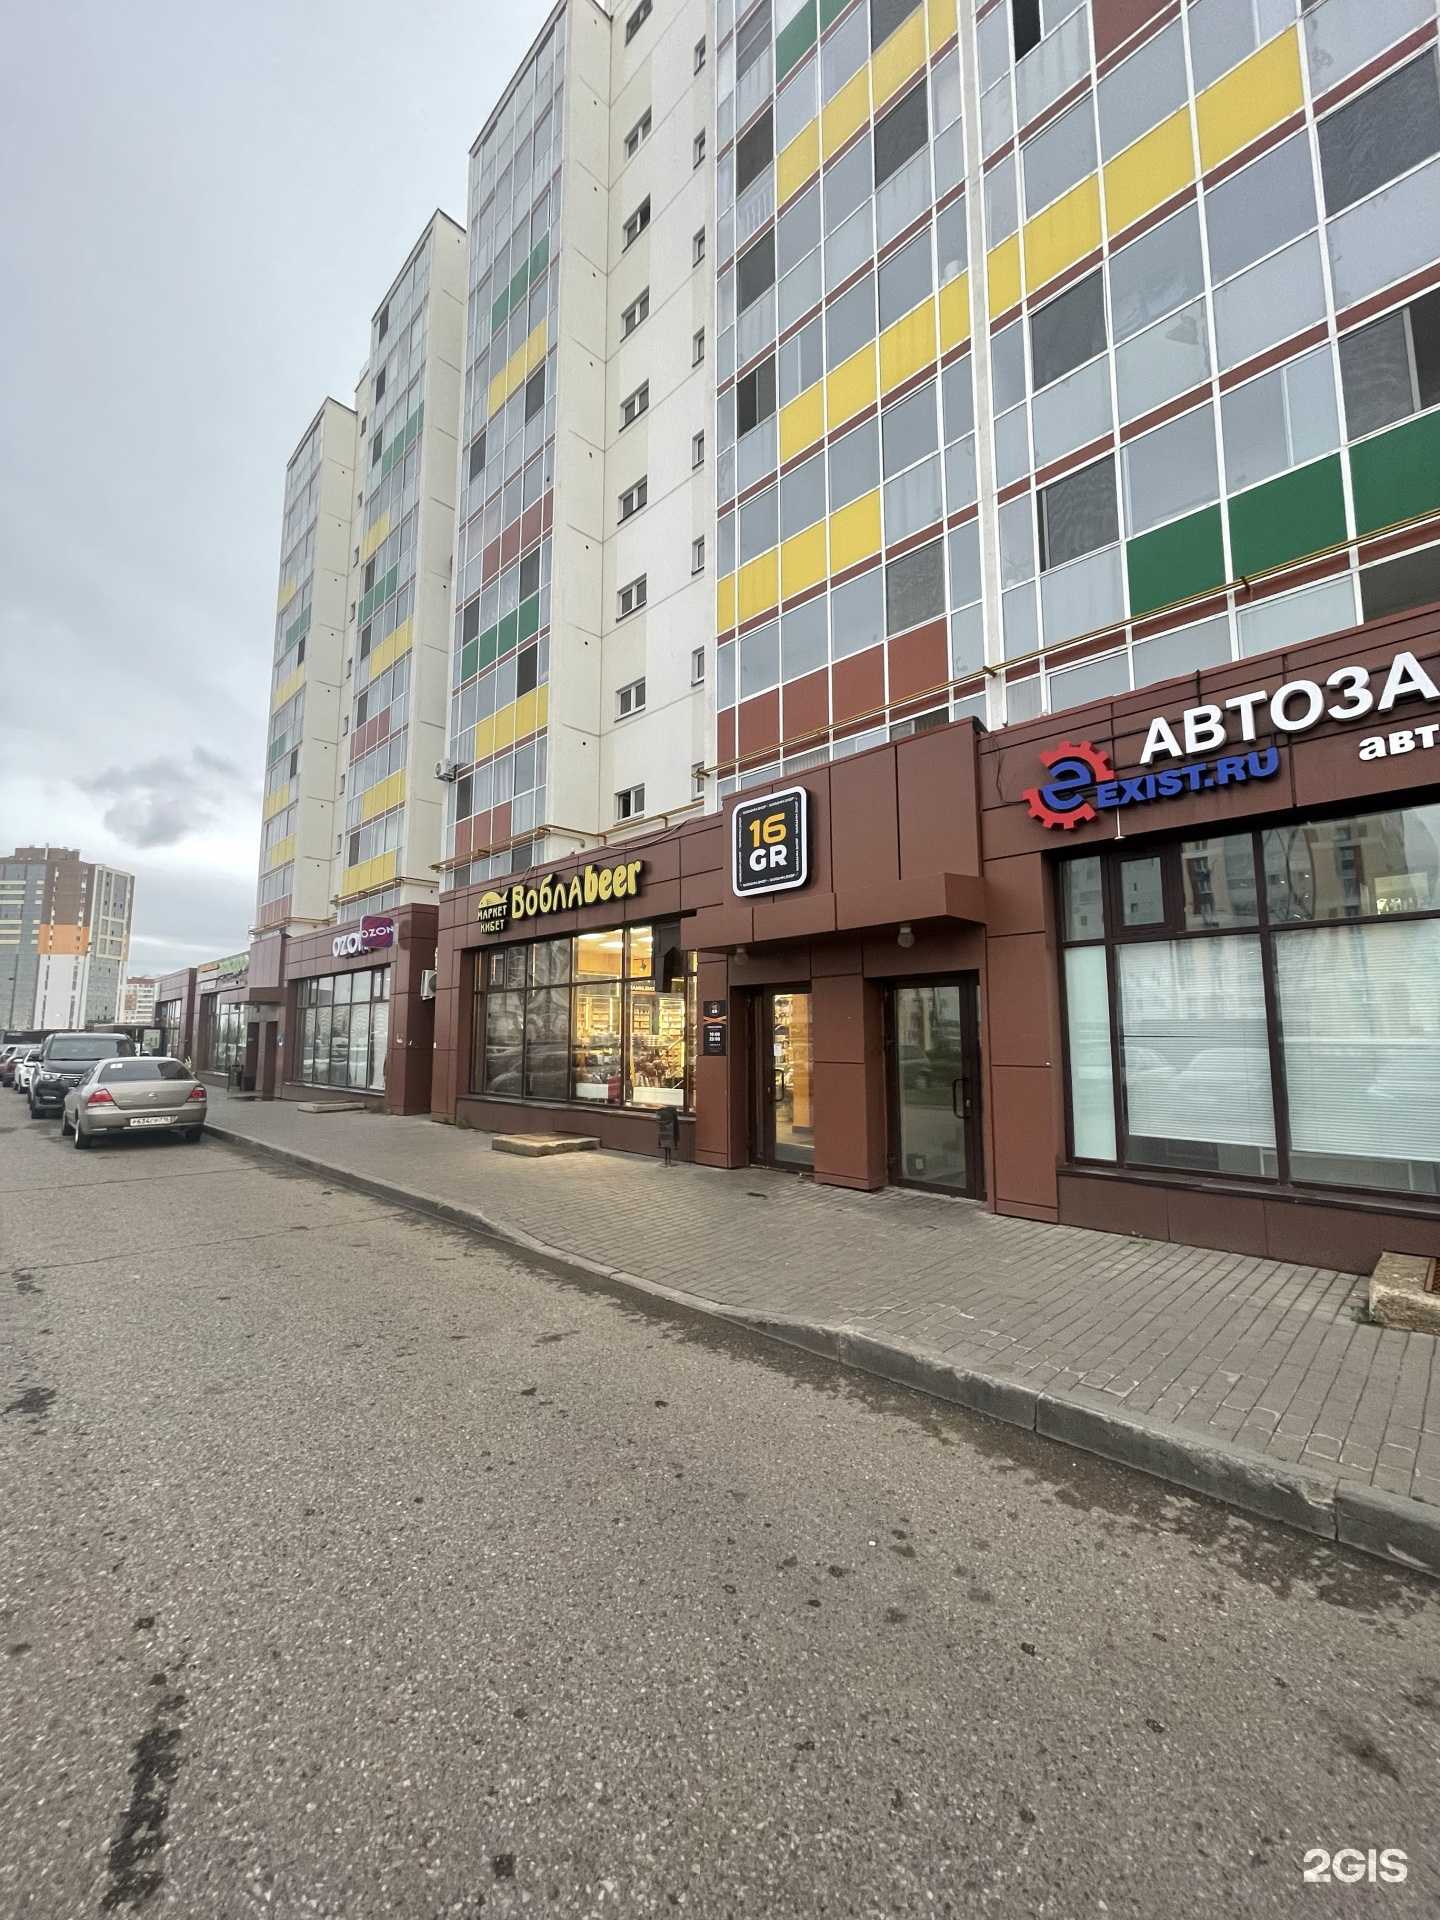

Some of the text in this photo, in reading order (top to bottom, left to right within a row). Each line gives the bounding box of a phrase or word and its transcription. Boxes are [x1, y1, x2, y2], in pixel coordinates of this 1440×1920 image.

[1139, 650, 1440, 766] АВТОЗА
[1097, 745, 1280, 810] EXIST.RU
[749, 811, 787, 848] 16
[749, 844, 787, 872] GR
[477, 905, 508, 922] МАРКЕТ
[480, 919, 505, 933] КИБЕТ
[362, 926, 394, 938] OZON
